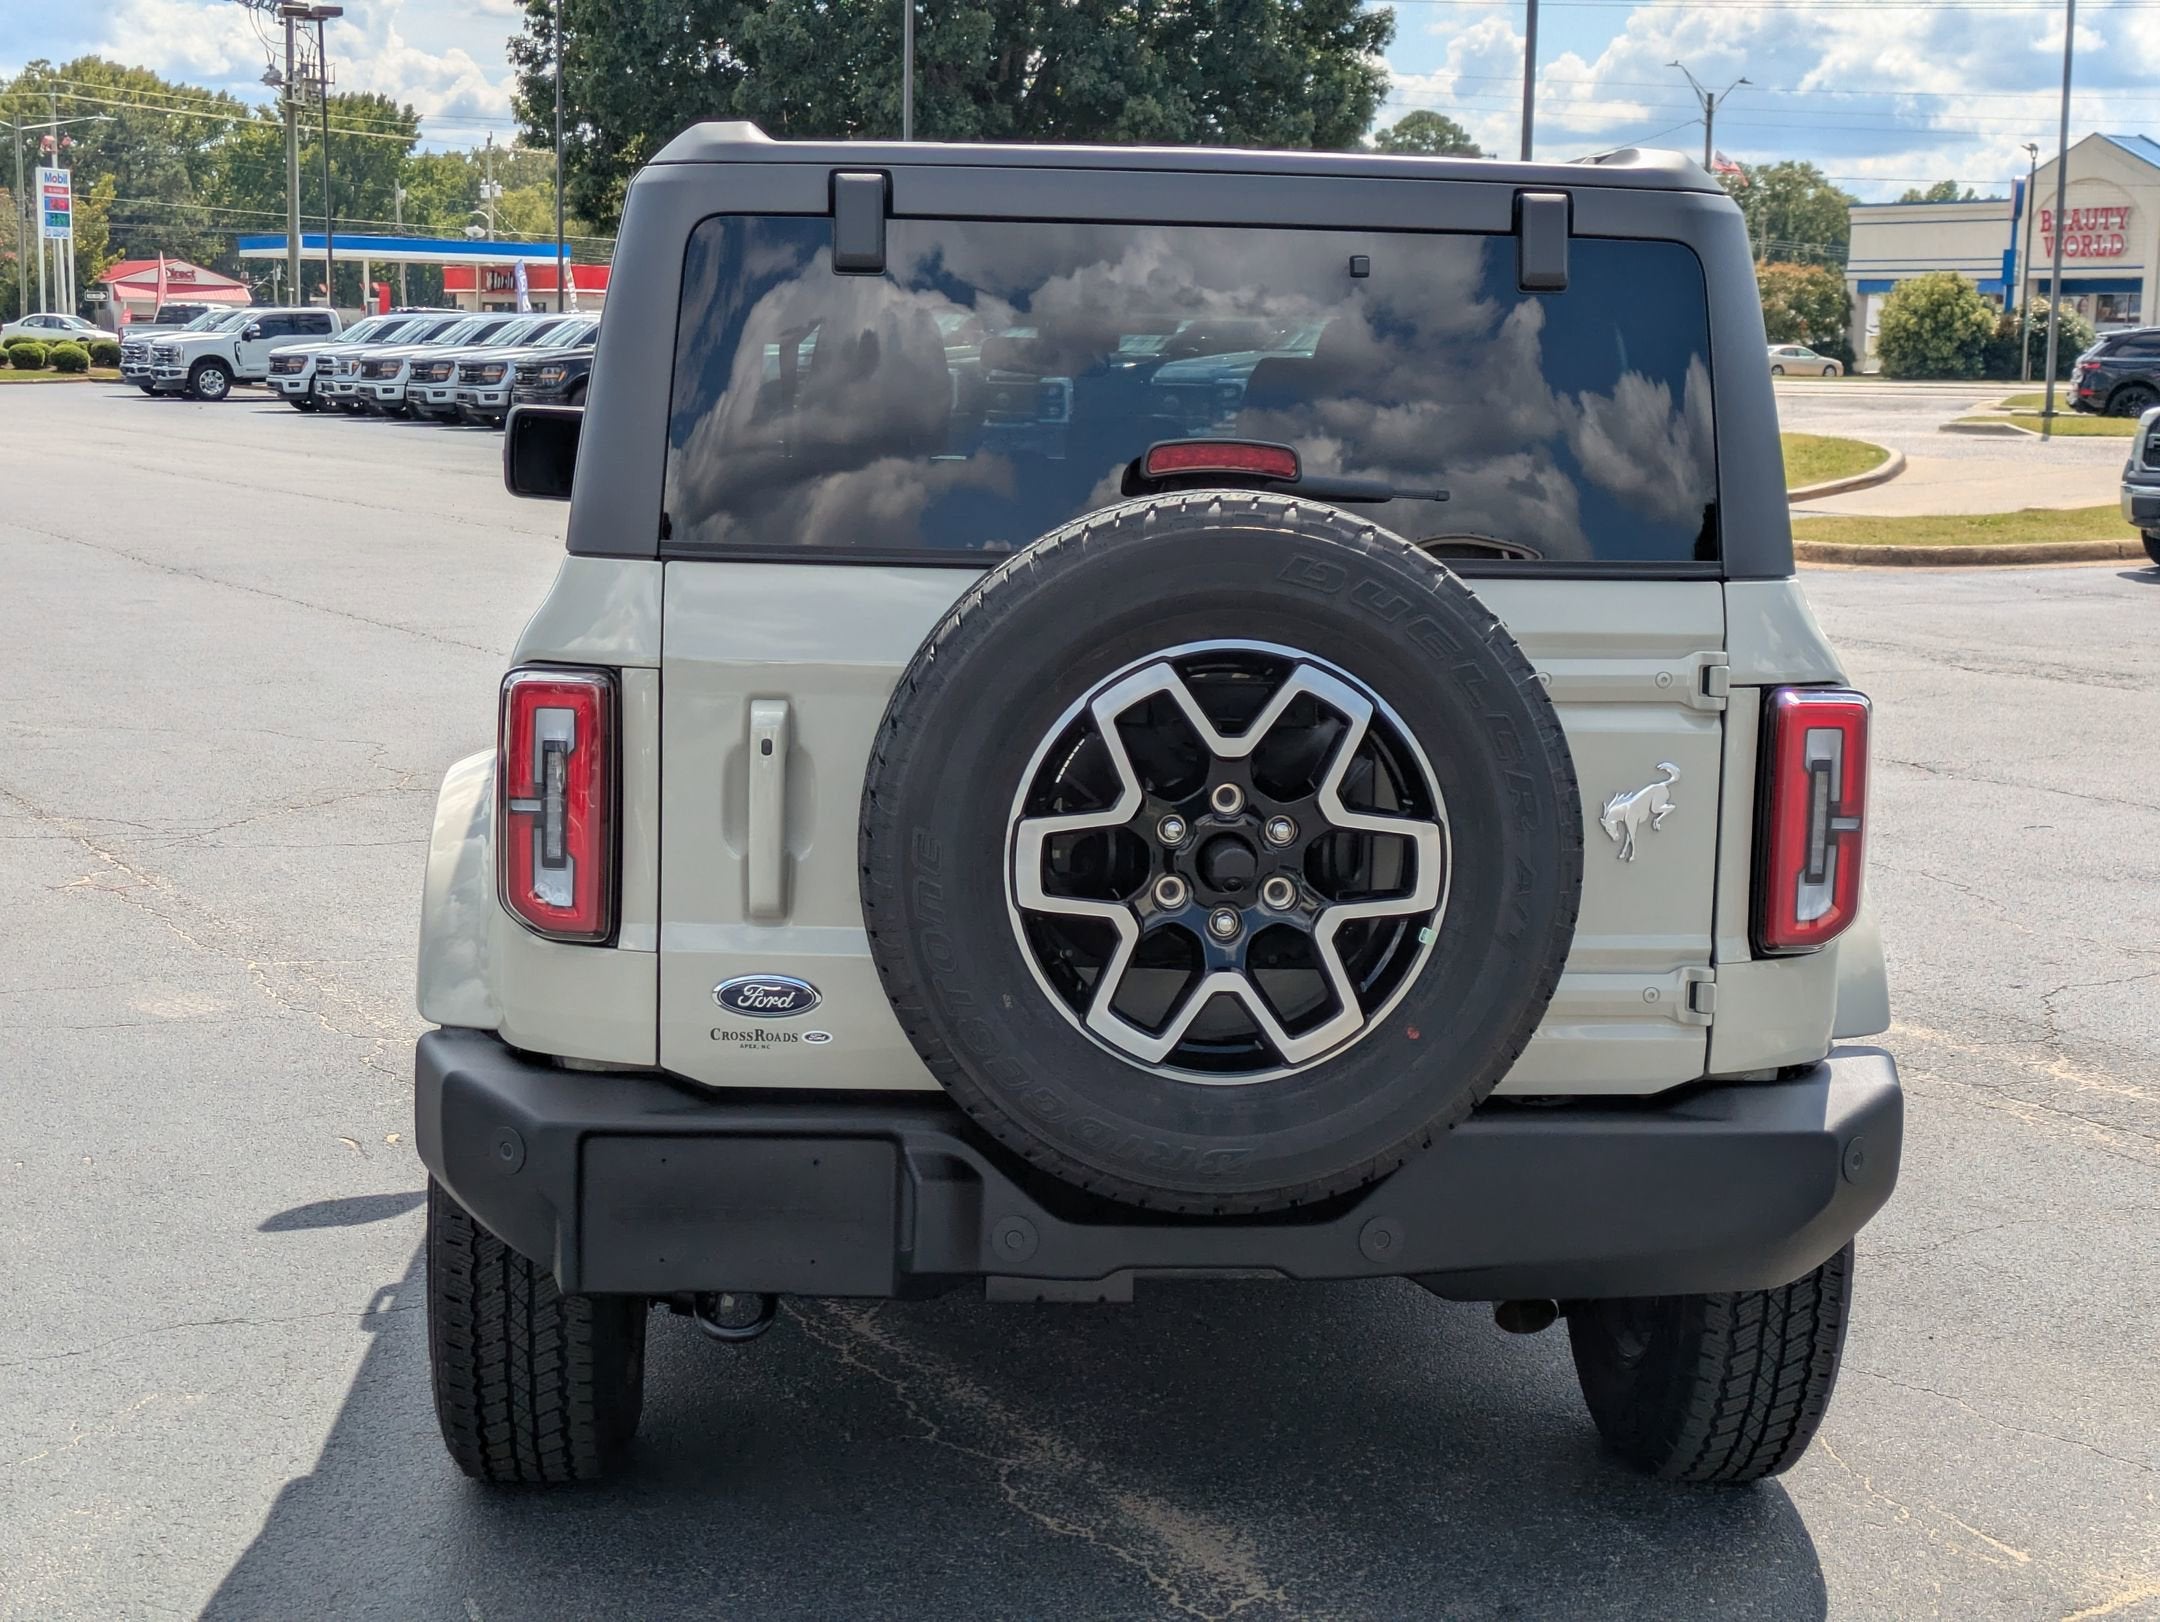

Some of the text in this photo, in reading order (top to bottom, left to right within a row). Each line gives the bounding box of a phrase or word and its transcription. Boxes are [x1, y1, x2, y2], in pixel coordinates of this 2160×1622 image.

[44, 171, 68, 185] Mobil
[2040, 206, 2130, 232] BAUTY
[737, 984, 796, 1008] Ford
[910, 827, 1256, 1176] BRIDGESTONE
